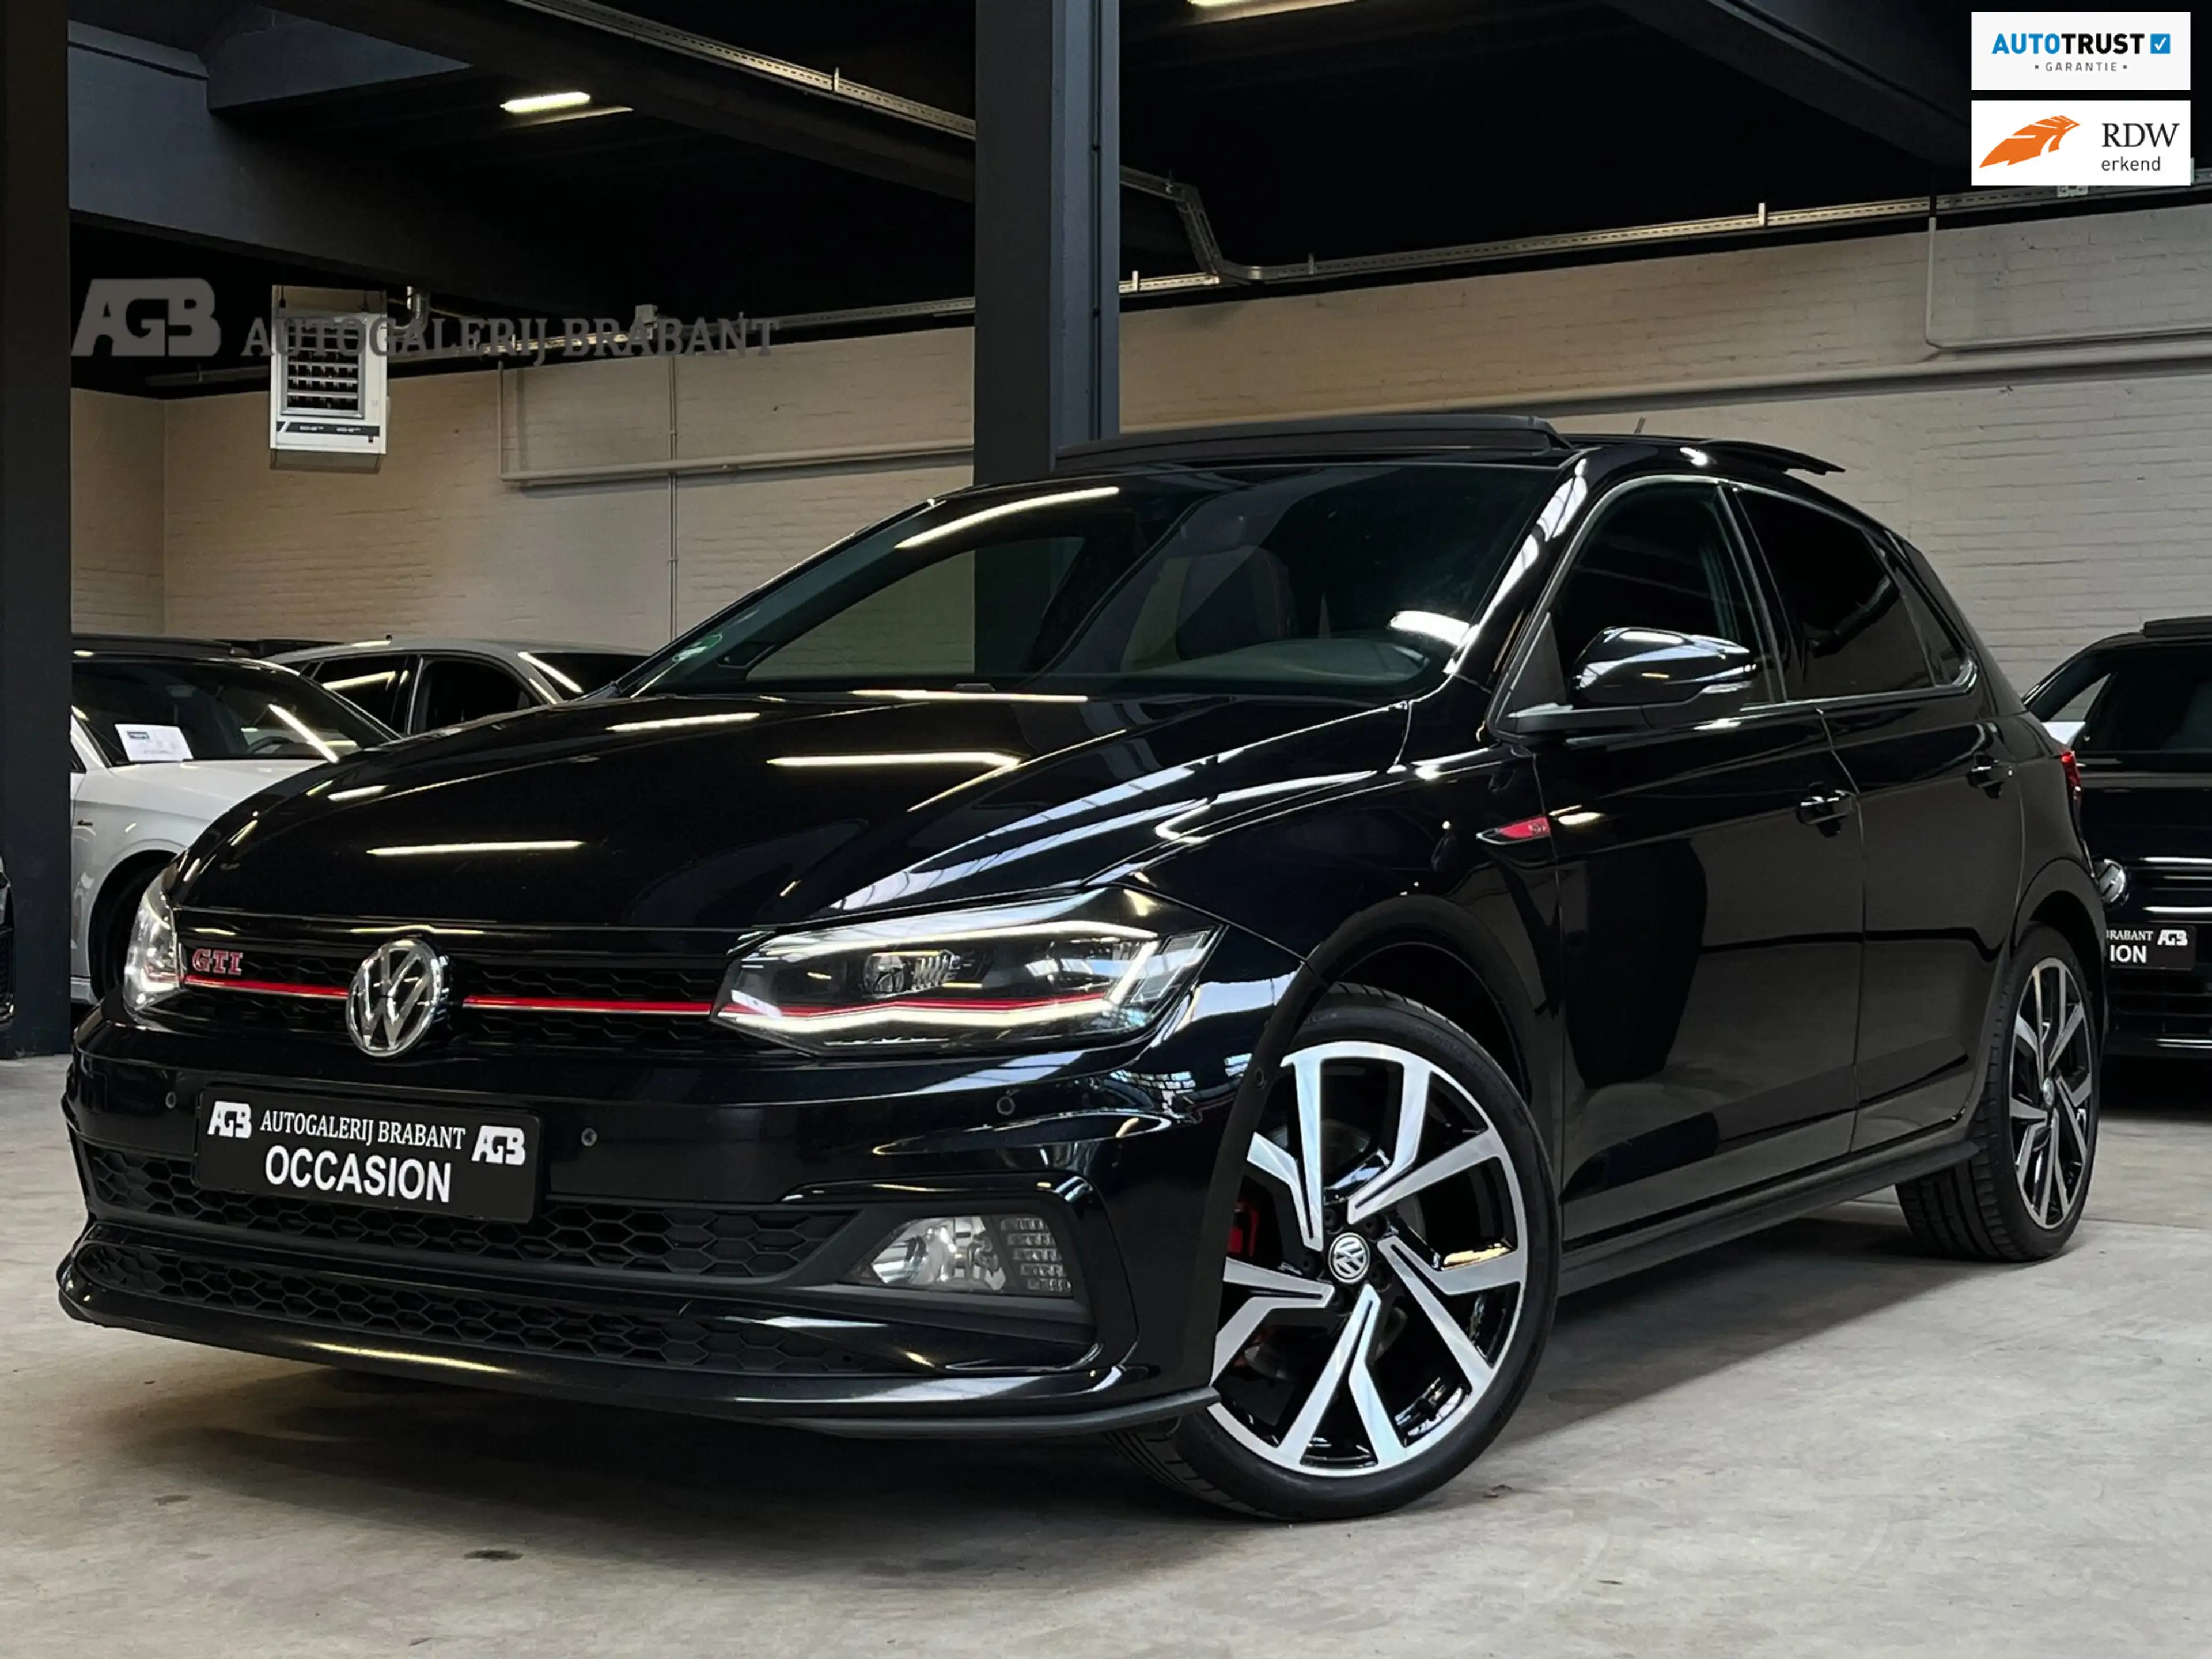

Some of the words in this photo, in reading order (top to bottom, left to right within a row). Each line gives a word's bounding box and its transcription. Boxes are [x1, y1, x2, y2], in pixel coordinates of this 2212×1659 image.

[192, 949, 243, 975] GTI
[207, 1101, 252, 1138] AGB
[260, 1109, 374, 1146] AUTOGALERIJ
[377, 1120, 466, 1150] BRABANT
[471, 1125, 527, 1165] AGB
[264, 1145, 452, 1203] OCCASION
